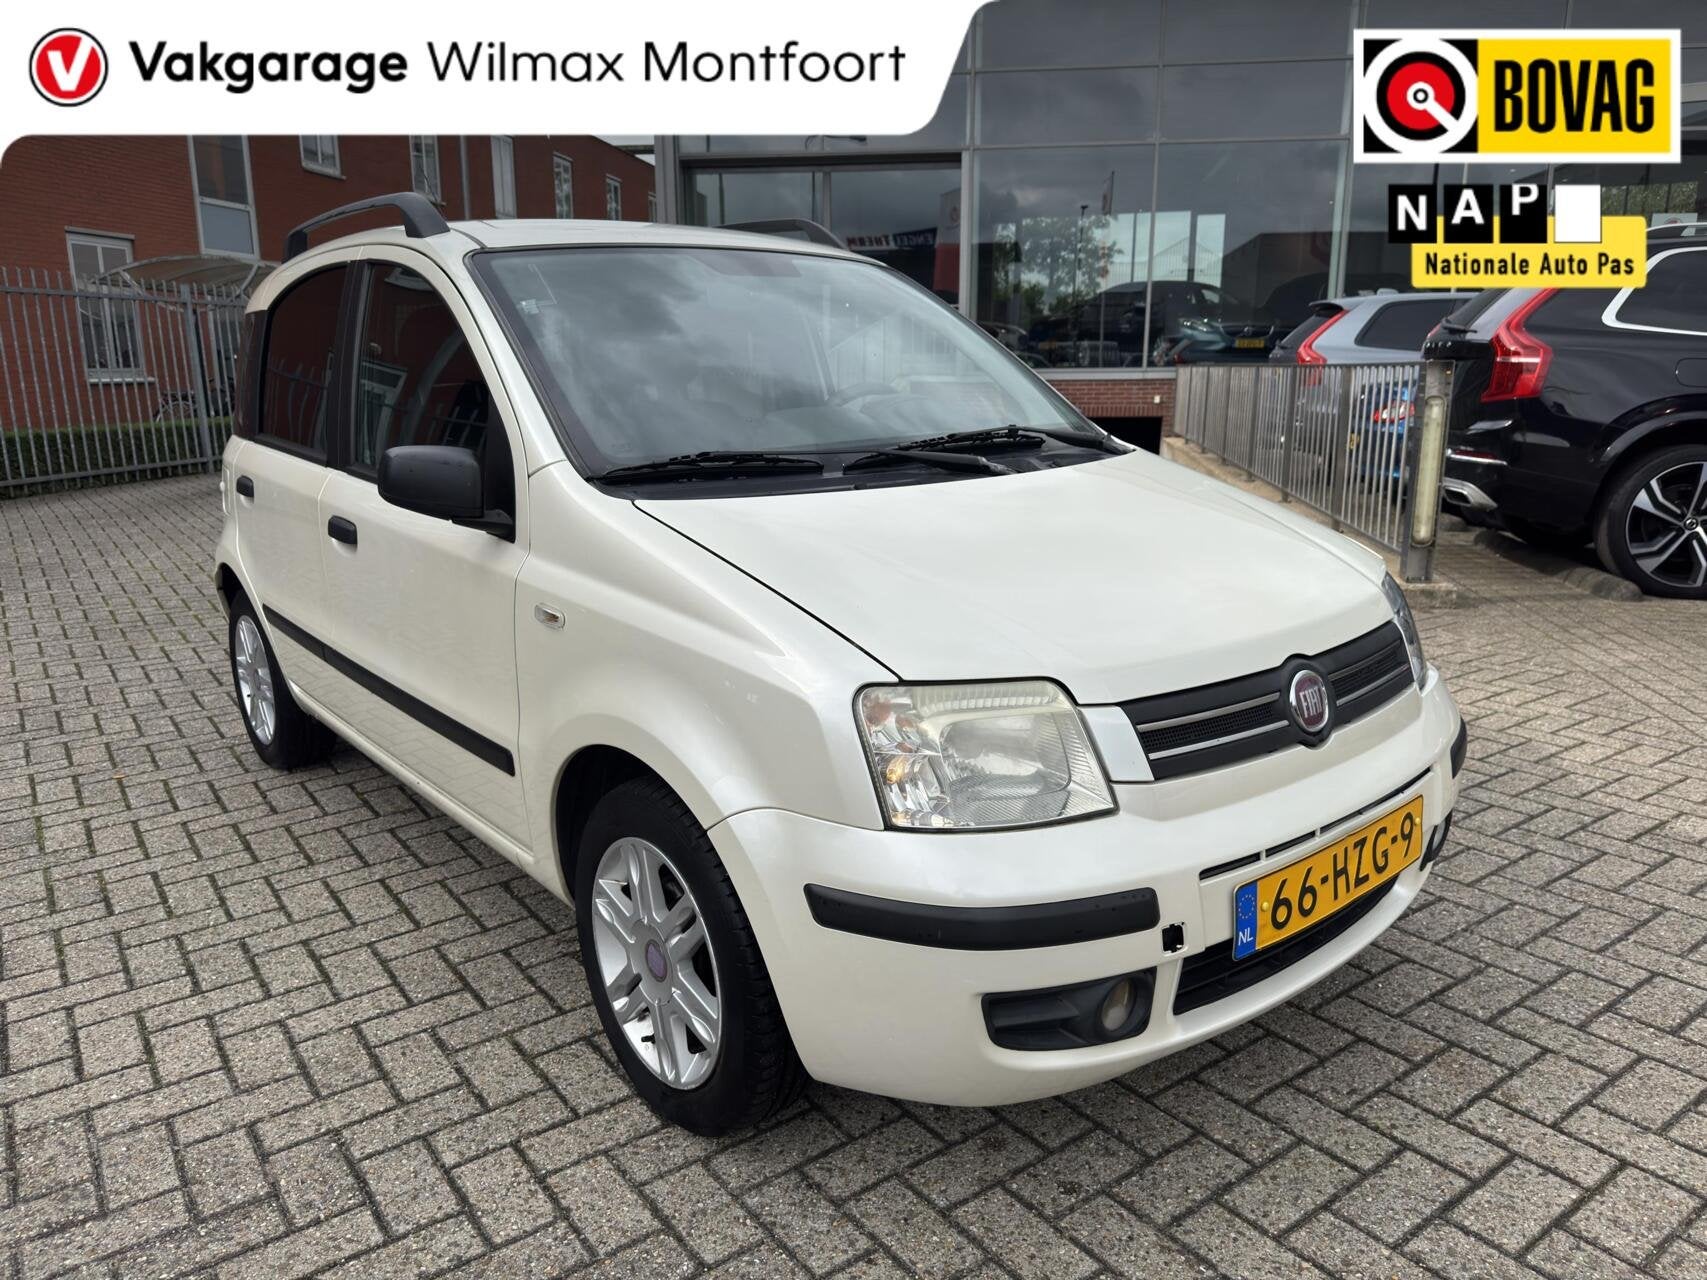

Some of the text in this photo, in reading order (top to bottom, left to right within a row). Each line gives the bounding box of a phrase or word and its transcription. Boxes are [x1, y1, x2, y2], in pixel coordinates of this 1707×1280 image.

[1299, 686, 1323, 718] FIAT
[1270, 811, 1414, 930] 66-HZG-9
[1237, 927, 1253, 946] NL
